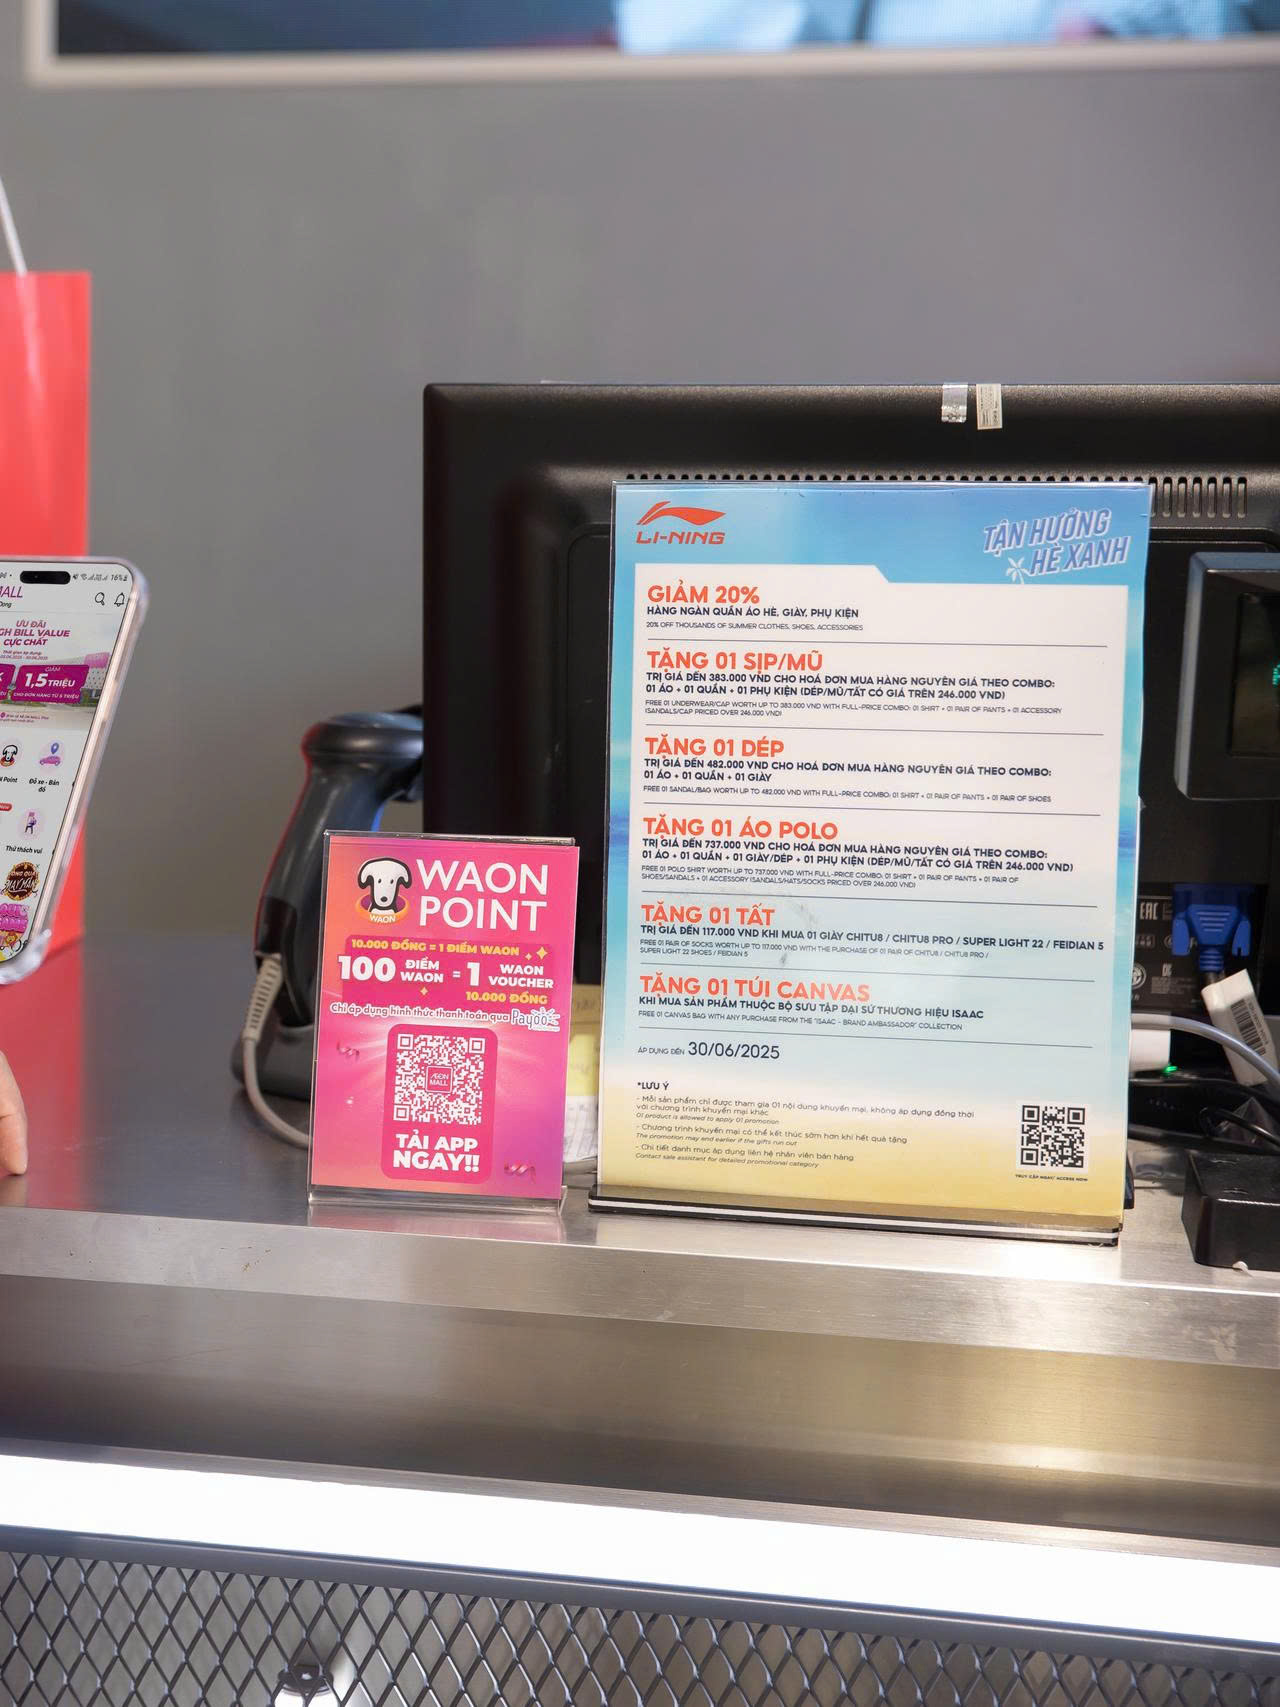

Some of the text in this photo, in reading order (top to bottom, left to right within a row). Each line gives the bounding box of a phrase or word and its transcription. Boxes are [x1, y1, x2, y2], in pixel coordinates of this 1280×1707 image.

[636, 531, 725, 545] LI-NING
[984, 507, 1111, 557] TẬN HƯỞNG
[1030, 536, 1131, 576] HÈ XANH
[648, 580, 760, 604] GIẢM 20%
[647, 605, 859, 619] HÀNG NGÀN QUẦN ÁO HÈ, GIÀY, PHỤ KIỆN
[13, 628, 35, 637] BILL
[37, 629, 70, 637] VALUE
[16, 620, 47, 628] ƯU ĐÃI
[675, 621, 716, 629] THOUSANDS
[3, 637, 48, 648] CỰC CHẤT
[647, 647, 823, 674] TẶNG 01 SỊP/MŨ
[24, 672, 75, 689] 1,5 TRIỆU
[646, 671, 1055, 688] TRỊ GIÁ ĐẾN 383.000 VND CHO HOÁ ĐƠN MUA HÀNG NGUYÊN GIÁ THEO COMBO:
[644, 734, 785, 759] TẶNG 01 DÉP
[643, 814, 838, 841] TẶNG 01 ÁO POLO
[416, 859, 548, 895] WAON
[370, 913, 396, 924] WAON
[420, 896, 548, 931] POINT
[641, 901, 775, 928] TẶNG 01 TẤT
[640, 925, 656, 935] TRỊ
[658, 923, 677, 935] GIÁ
[680, 924, 700, 935] ĐẾN
[702, 927, 735, 937] 117.000
[737, 928, 759, 938] VND
[762, 929, 778, 938] KHI
[781, 930, 805, 939] MUA
[807, 931, 817, 940] 01
[819, 930, 844, 941] GIÀY
[846, 932, 883, 942] CHITU8
[892, 934, 930, 944] CHITU8
[932, 936, 954, 945] PRO
[963, 936, 996, 947] SUPER
[999, 938, 1030, 948] LIGHT
[1032, 939, 1044, 948] 22
[1053, 940, 1095, 950] FEIDIAN
[1098, 942, 1104, 950] 5
[351, 939, 389, 950] 10.000
[391, 940, 426, 951] ĐỒNG
[447, 941, 477, 954] ĐIỂM
[480, 945, 519, 956] WAON
[338, 955, 396, 982] 100
[405, 956, 439, 970] ĐIỂM
[500, 964, 544, 976] WAON
[400, 971, 444, 983] WAON
[467, 962, 480, 987] 1
[488, 976, 554, 989] VOUCHER
[640, 973, 869, 1002] TẶNG 01 TÚI CANVAS
[466, 991, 548, 1005] 10.000 ĐỒNG
[639, 994, 984, 1019] KHI MUA SẢN PHẨM THUỘC BỘ SƯU TẬP ĐẠI SỨ THƯƠNG HIỆU ISAAC
[349, 1004, 361, 1015] áp
[364, 1005, 387, 1016] dụng
[413, 1007, 434, 1017] thức
[436, 1008, 462, 1018] thanh
[466, 1010, 487, 1020] toán
[490, 1013, 509, 1022] qua
[512, 1009, 550, 1029] Payoo
[688, 1042, 780, 1059] 30/06/2025
[663, 1082, 669, 1091] Ý
[396, 1129, 478, 1152] TẢI APP
[393, 1150, 480, 1173] NGAY!!
